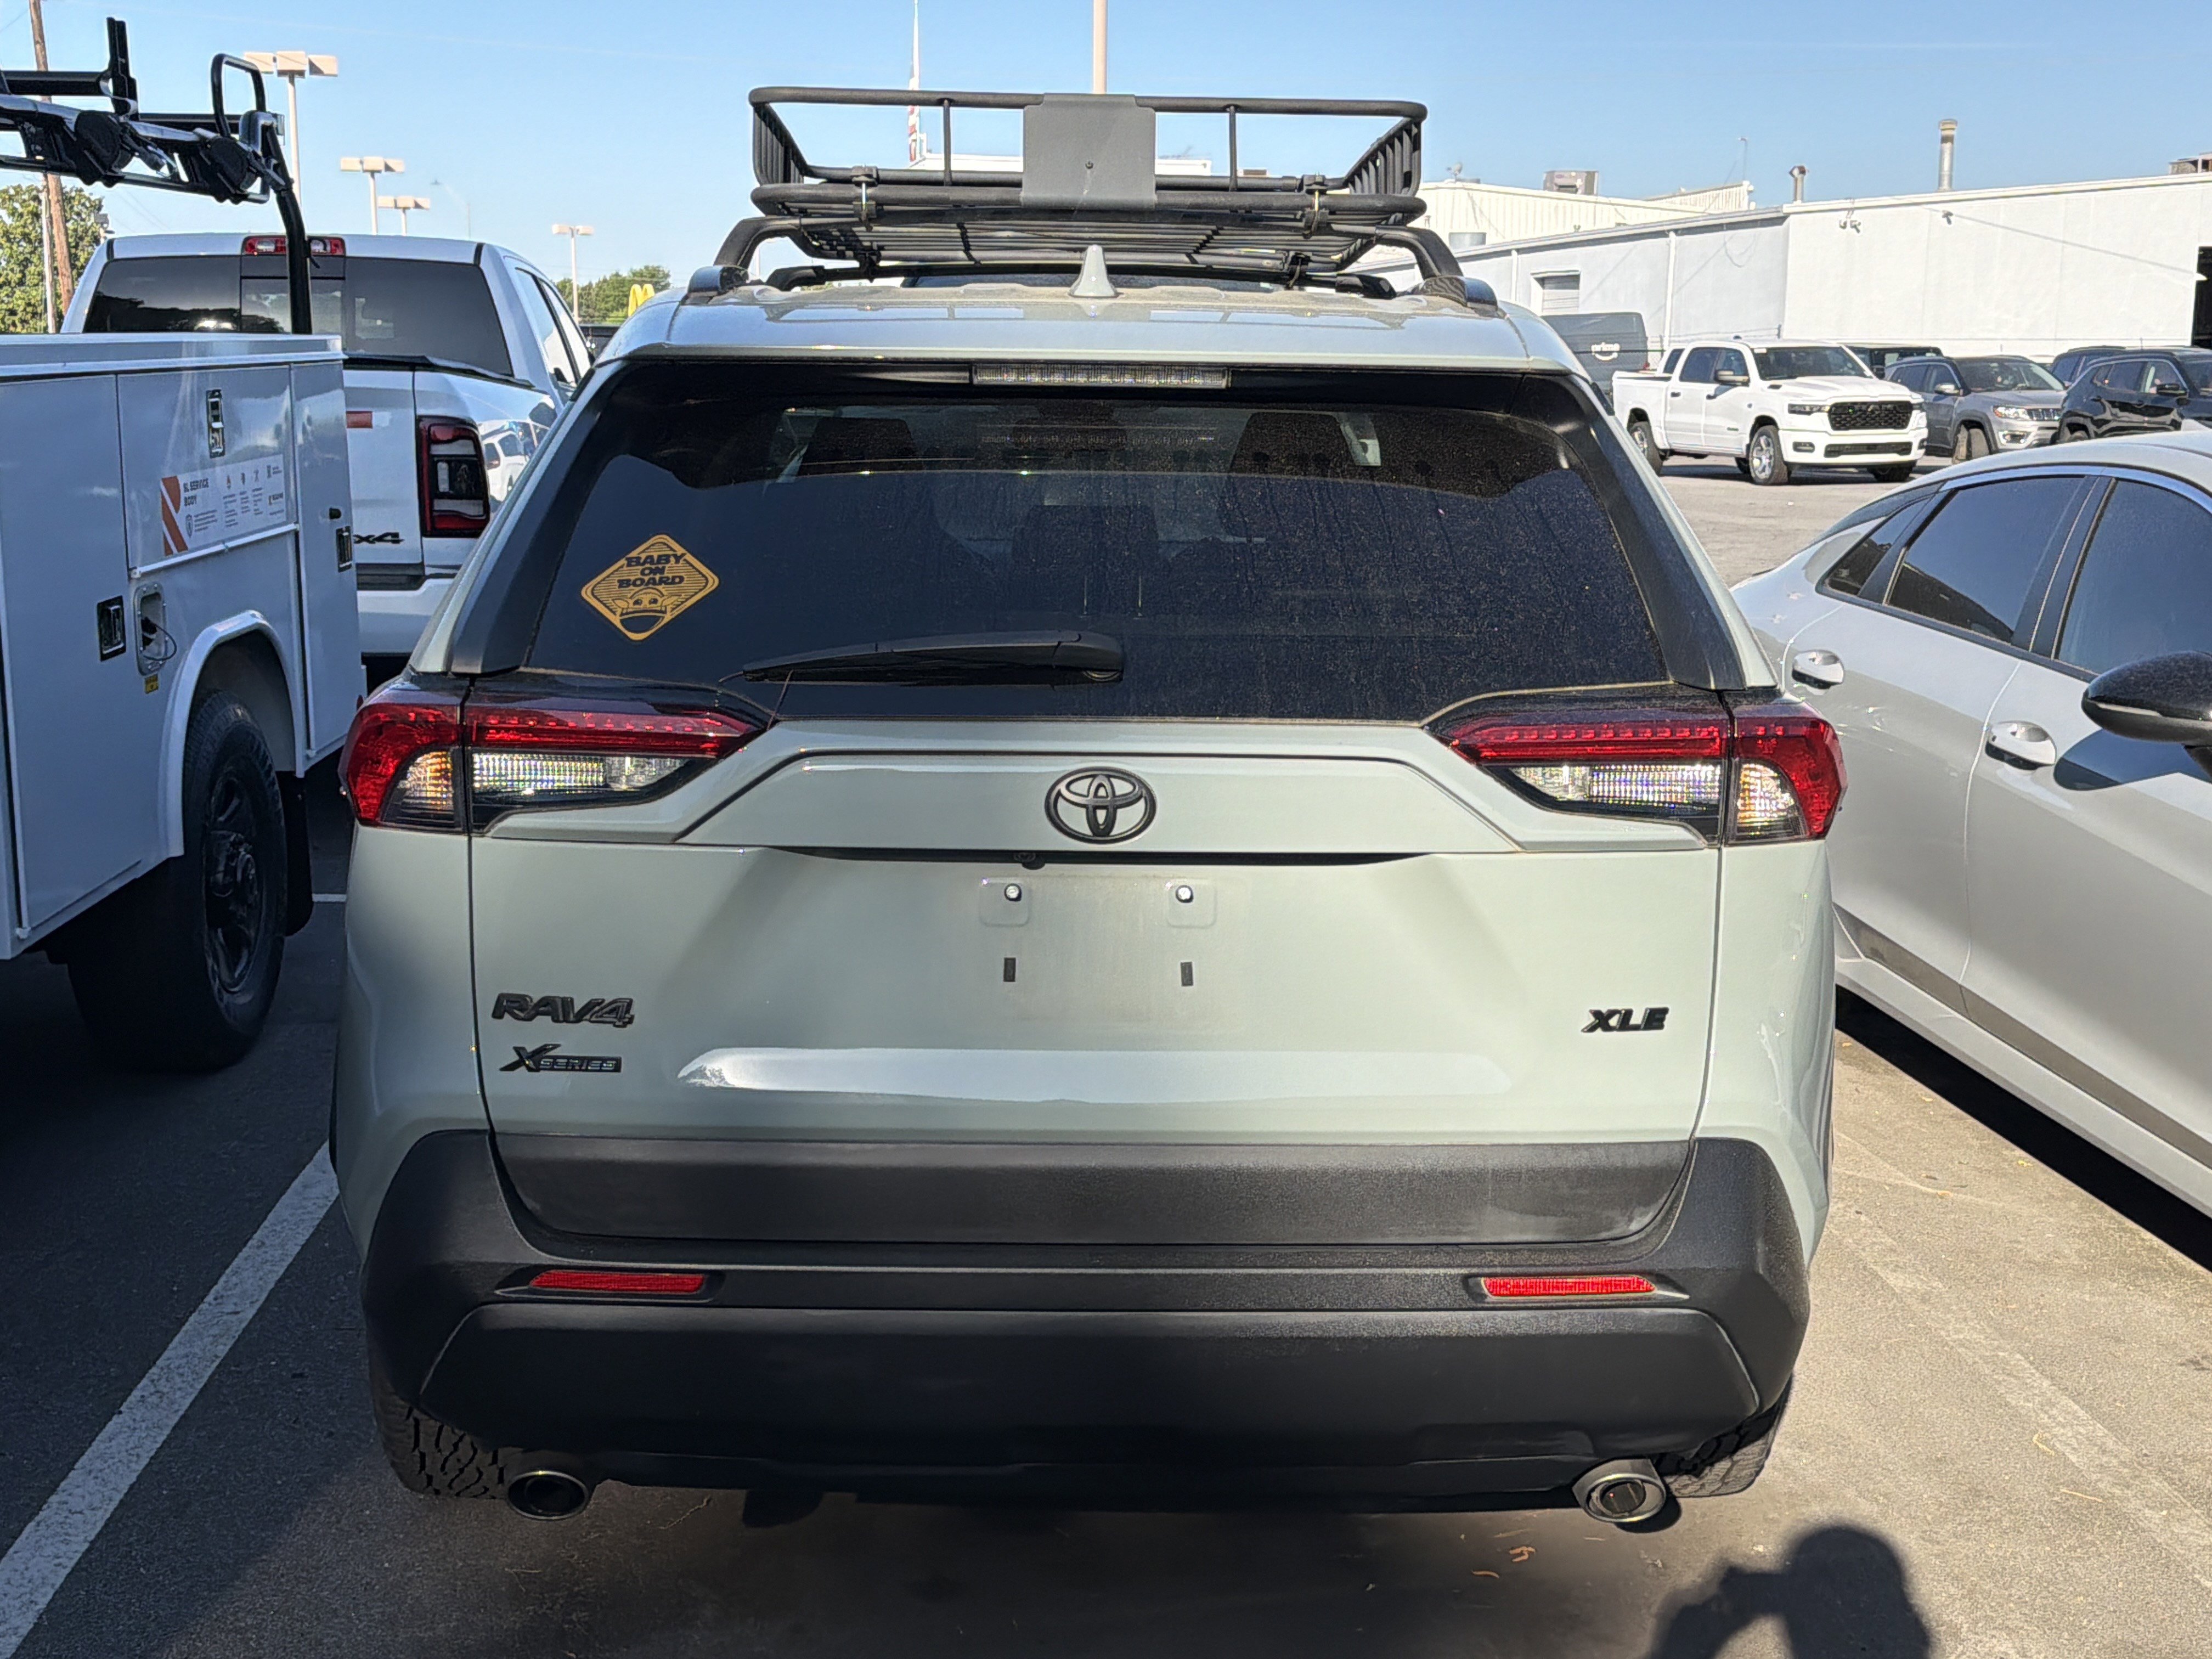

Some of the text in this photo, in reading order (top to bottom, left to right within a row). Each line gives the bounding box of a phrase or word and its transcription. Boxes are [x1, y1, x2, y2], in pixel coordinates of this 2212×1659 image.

[625, 553, 686, 568] BABY
[640, 566, 665, 576] ON
[617, 575, 685, 589] BOARD
[492, 992, 635, 1029] RAV4
[1581, 1007, 1669, 1033] XLE
